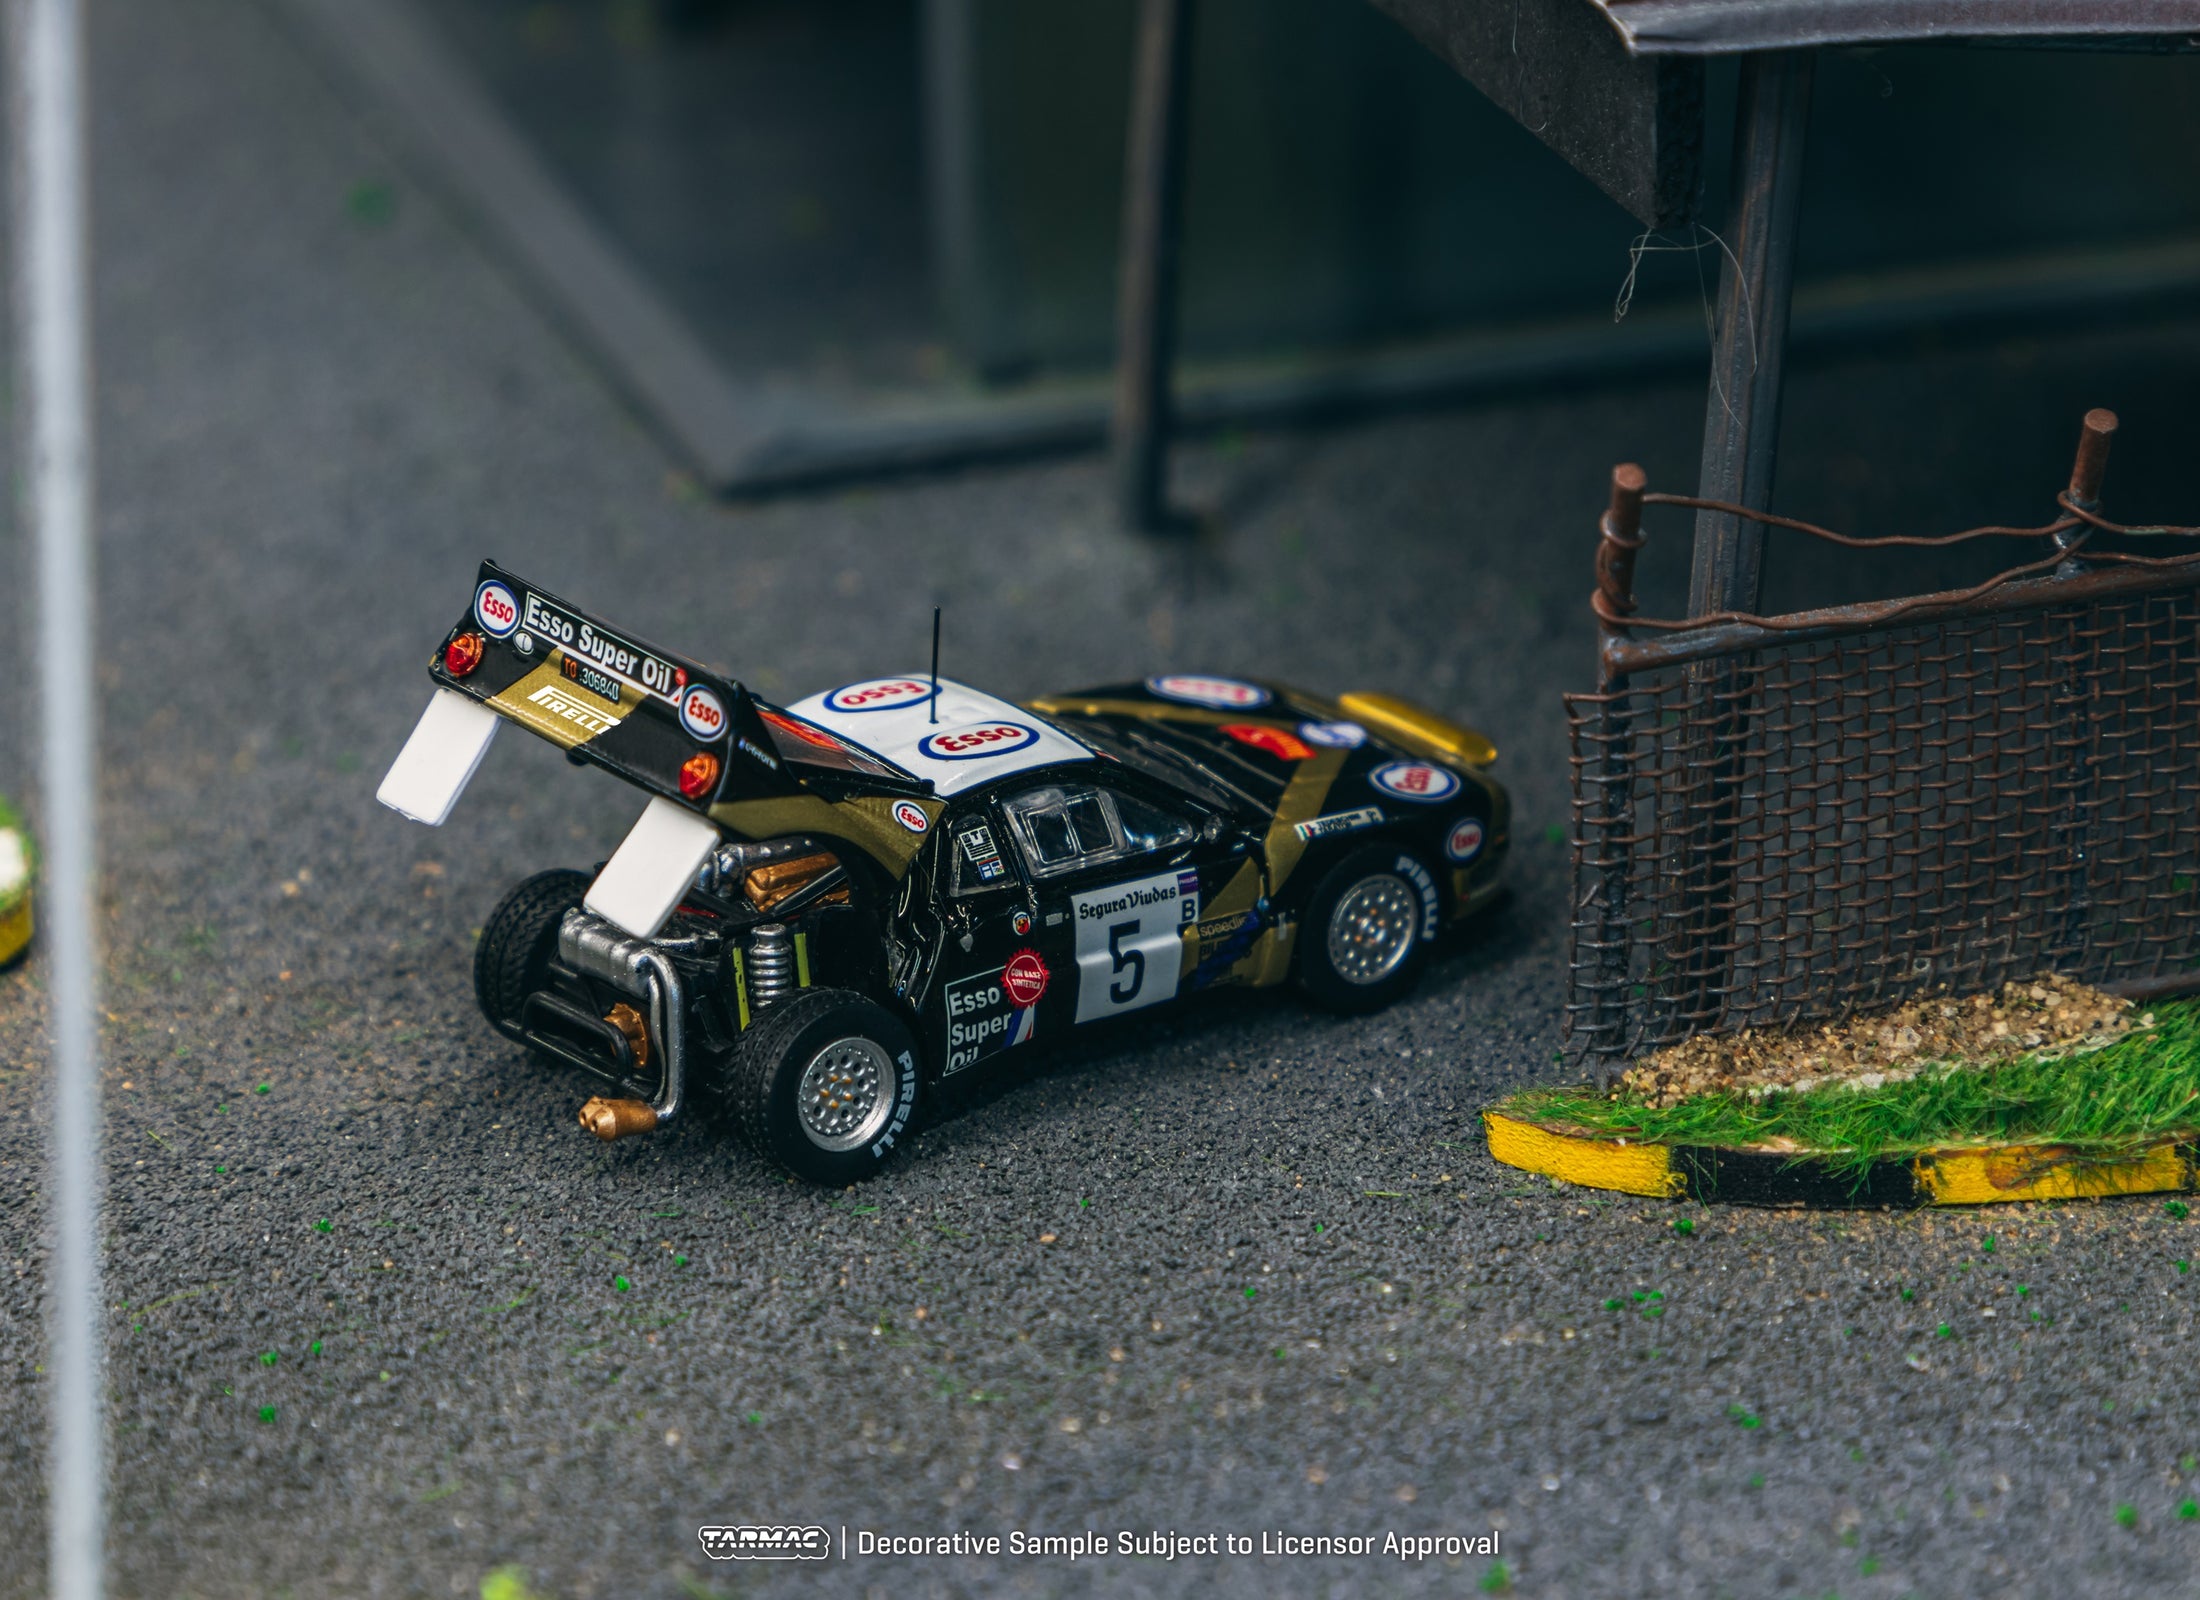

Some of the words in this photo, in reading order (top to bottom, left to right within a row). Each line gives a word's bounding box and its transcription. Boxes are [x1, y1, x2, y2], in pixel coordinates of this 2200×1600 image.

[483, 591, 514, 623] Esso
[526, 596, 573, 643] Esso
[578, 624, 638, 676] Super
[642, 657, 671, 694] Oil
[564, 657, 578, 679] TO
[527, 684, 622, 735] PIRELLI
[840, 681, 926, 706] Esso
[688, 695, 720, 727] Esso
[935, 726, 1023, 752] Esso
[901, 807, 925, 829] Esso
[1080, 900, 1127, 919] Segura
[1126, 886, 1177, 909] Viudas
[1181, 898, 1196, 921] B
[1396, 855, 1437, 940] PIRELLI
[1109, 919, 1145, 1004] 5
[949, 987, 1000, 1017] Esso
[951, 1012, 1012, 1046] Super
[949, 1046, 978, 1071] Oil
[871, 1050, 916, 1158] PIRELLI
